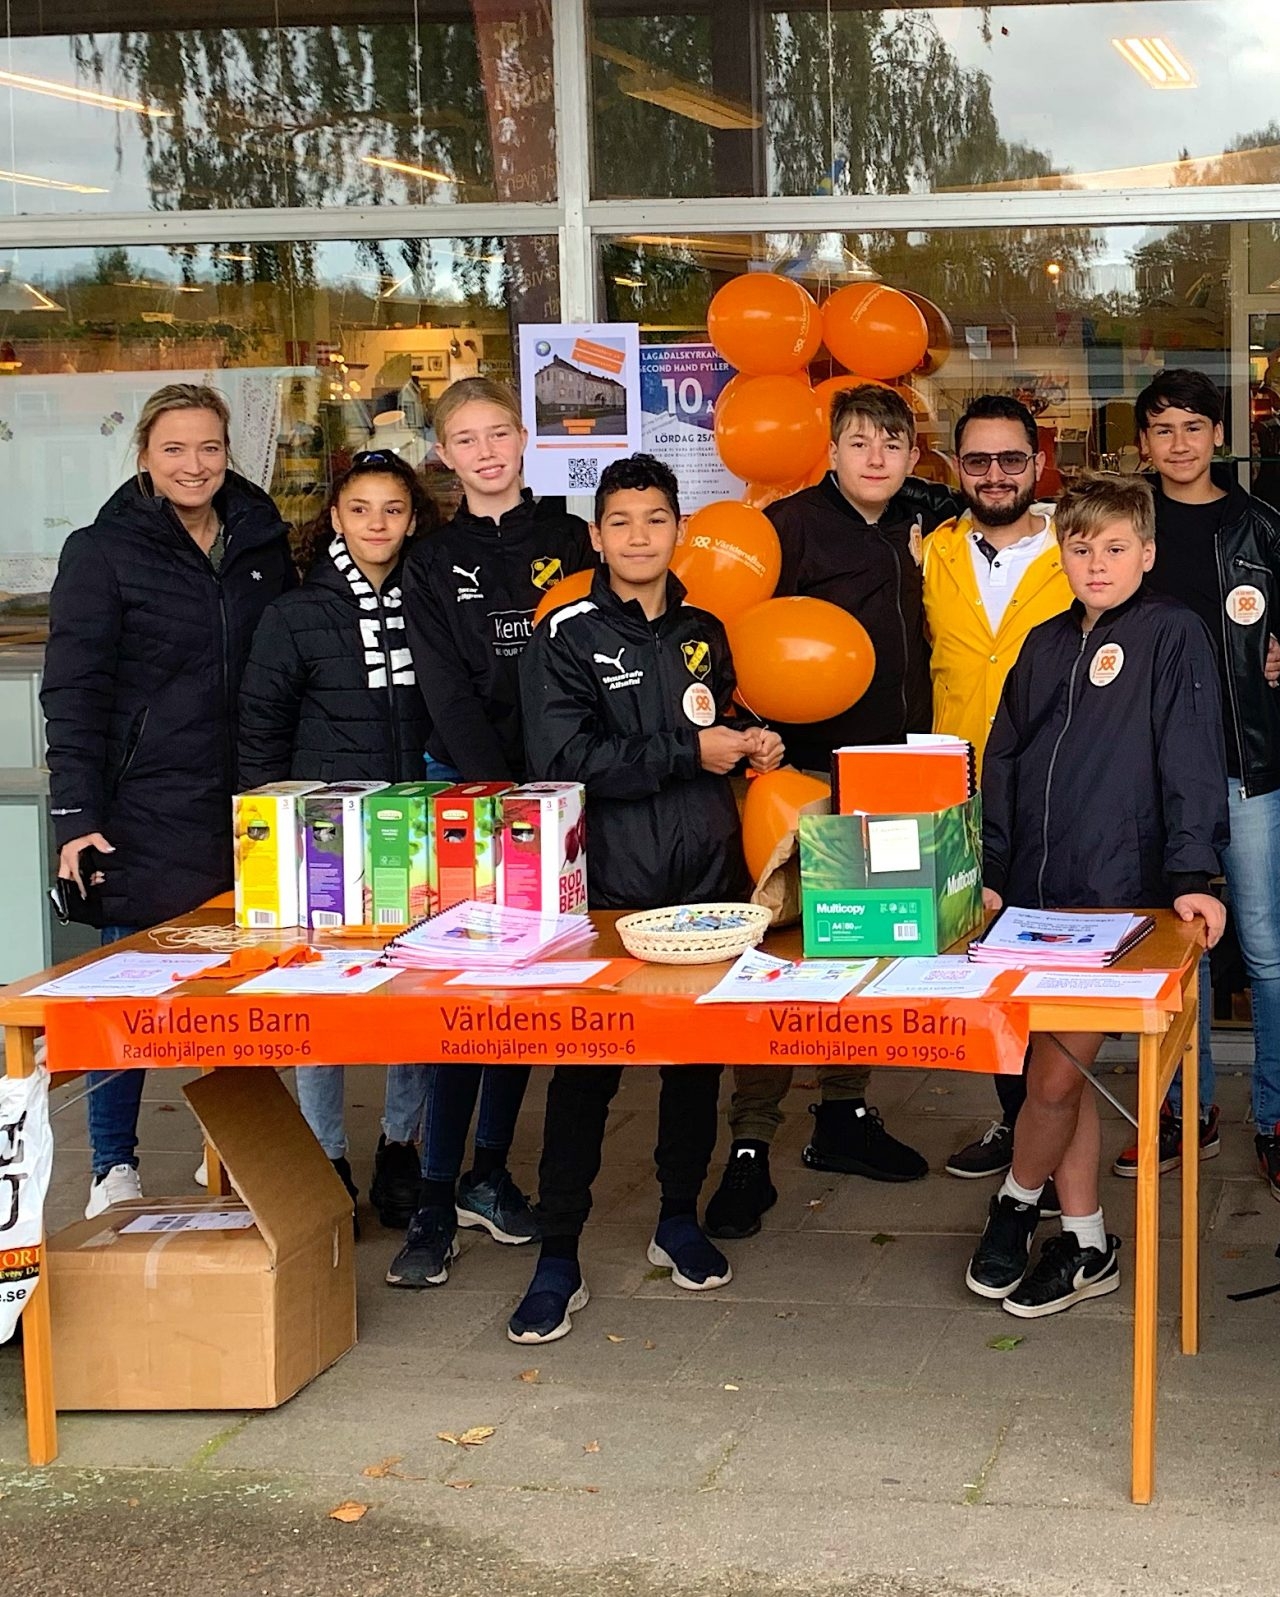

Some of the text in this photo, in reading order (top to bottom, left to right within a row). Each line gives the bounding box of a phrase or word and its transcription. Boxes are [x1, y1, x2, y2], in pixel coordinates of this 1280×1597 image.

[674, 364, 699, 372] HAND
[700, 363, 729, 371] FYLLER
[661, 377, 703, 414] 10
[655, 433, 695, 443] LÖRDAG
[546, 801, 552, 809] 3
[946, 866, 978, 897] Multicopy
[560, 884, 586, 914] BETA
[816, 903, 865, 915] Multicopy
[122, 1007, 311, 1034] Världens Barn
[440, 1004, 635, 1031] Världens Barn
[769, 1005, 967, 1035] Världens Barn
[123, 1039, 311, 1061] Radiohjälpen 90 1950-6
[441, 1038, 635, 1059] Radiohjälpen 90 1950-6
[769, 1040, 966, 1061] Radiohjälpen 90 1950-6
[26, 1266, 40, 1276] Da
